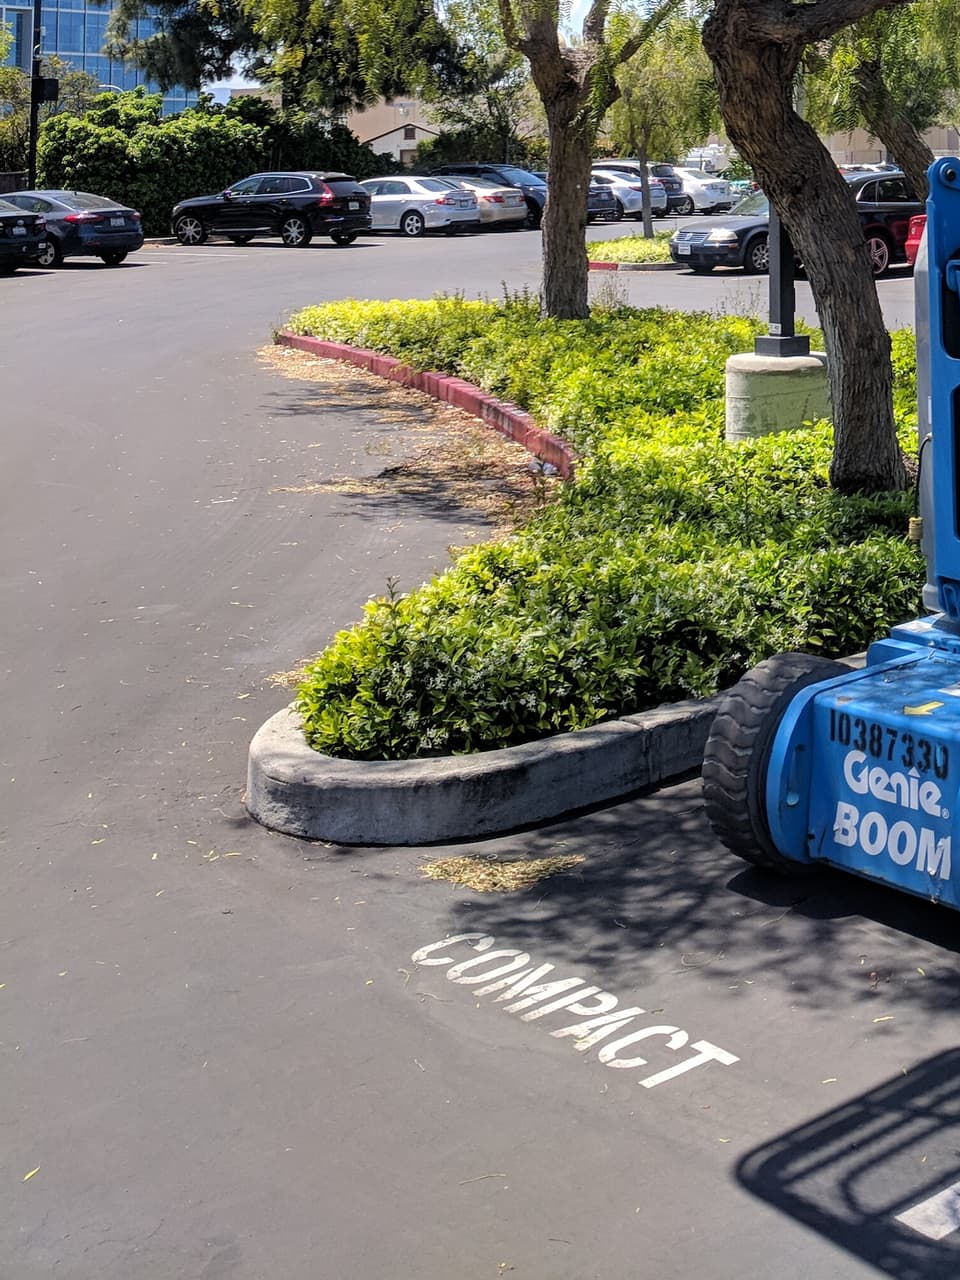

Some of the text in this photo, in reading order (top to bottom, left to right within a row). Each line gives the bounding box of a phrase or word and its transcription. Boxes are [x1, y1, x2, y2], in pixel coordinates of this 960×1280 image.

[828, 708, 950, 781] 10387330
[843, 749, 943, 818] Genie
[832, 800, 952, 881] BOOM
[410, 931, 741, 1089] COMPACT
